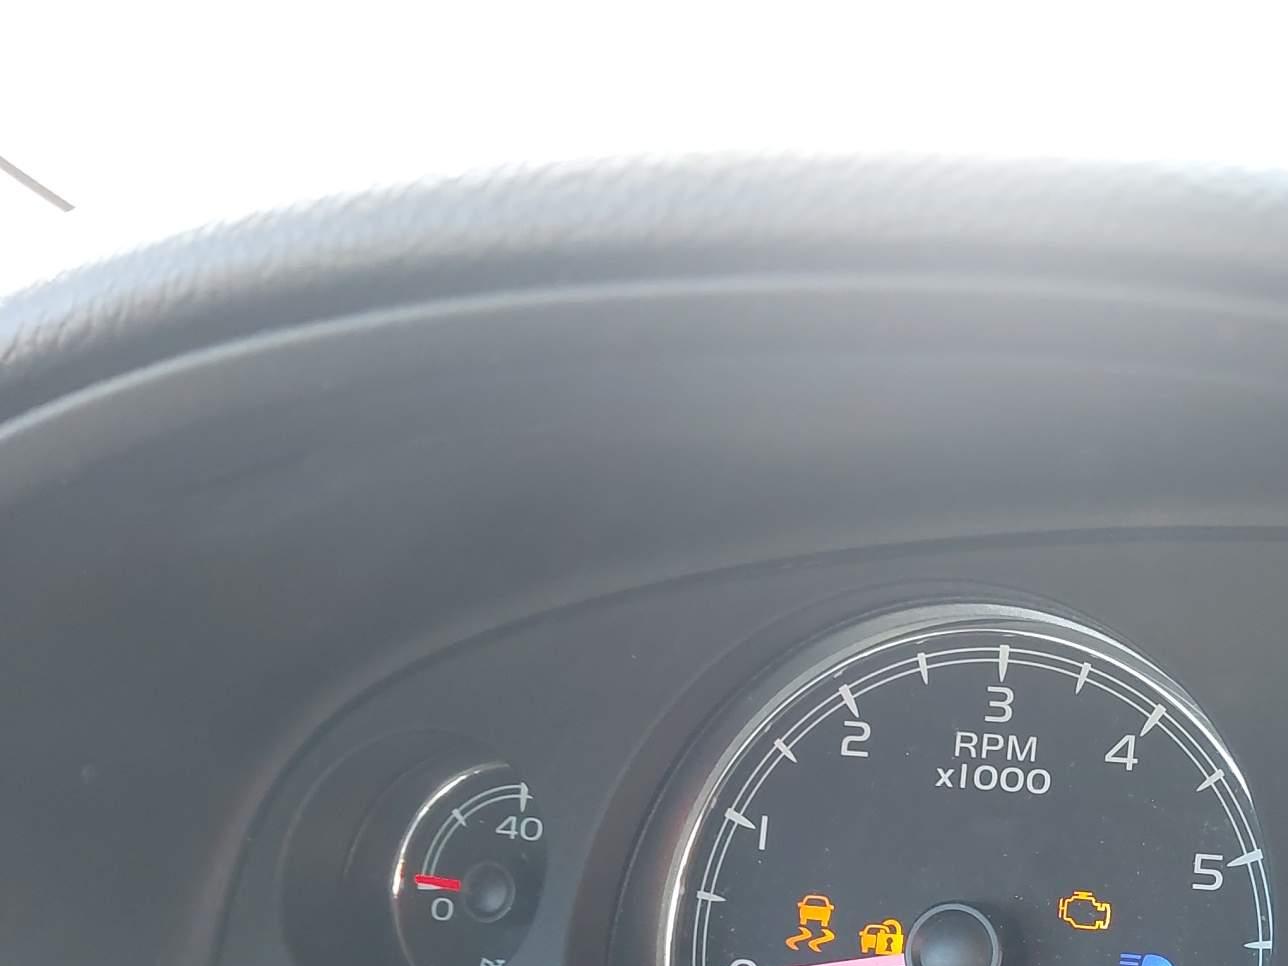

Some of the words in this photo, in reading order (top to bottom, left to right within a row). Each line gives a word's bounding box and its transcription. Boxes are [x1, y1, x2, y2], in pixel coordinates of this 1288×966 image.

[986, 686, 1014, 722] 3
[840, 720, 870, 758] 2
[953, 731, 1038, 763] RPM
[1104, 734, 1138, 771] 4
[934, 763, 1052, 795] x1000
[495, 816, 544, 841] 40
[757, 815, 769, 850] 1
[1191, 853, 1224, 892] 5
[431, 897, 455, 921] 0
